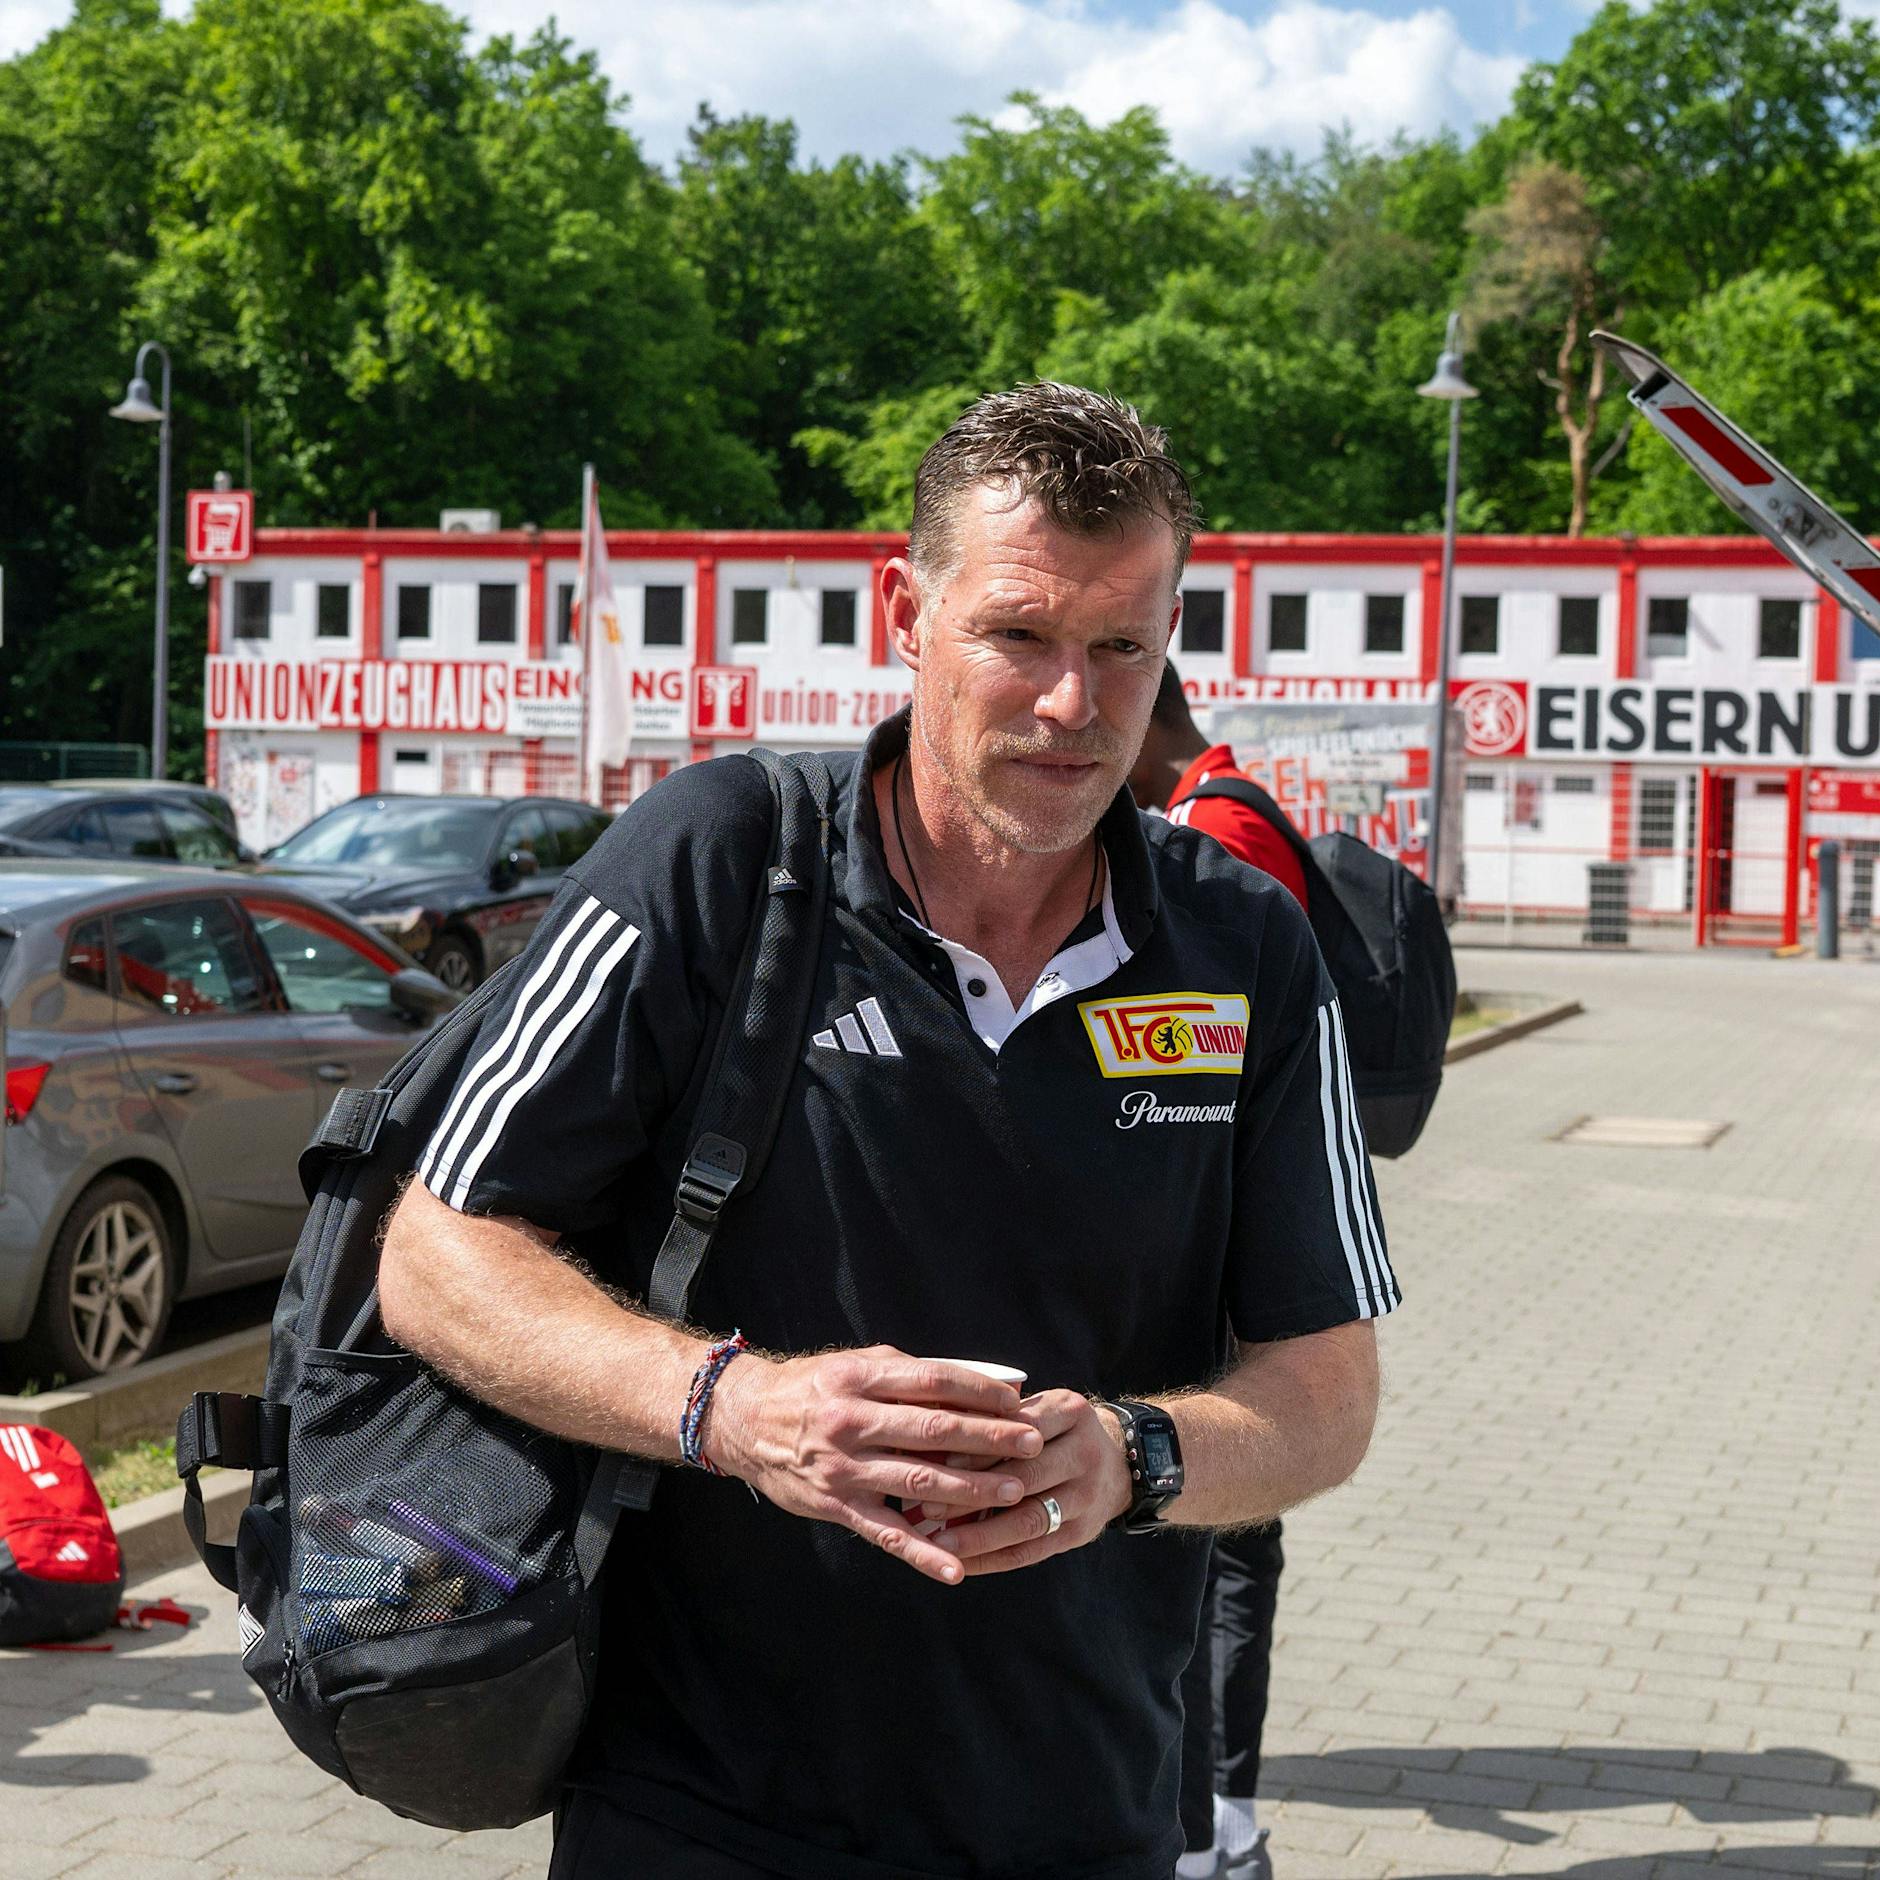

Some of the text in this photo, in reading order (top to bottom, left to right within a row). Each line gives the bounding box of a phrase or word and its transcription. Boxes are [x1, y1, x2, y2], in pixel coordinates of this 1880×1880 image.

[1537, 687, 1810, 755] EISERN
[1193, 1025, 1246, 1055] UNION
[1115, 1090, 1237, 1130] Paramount
